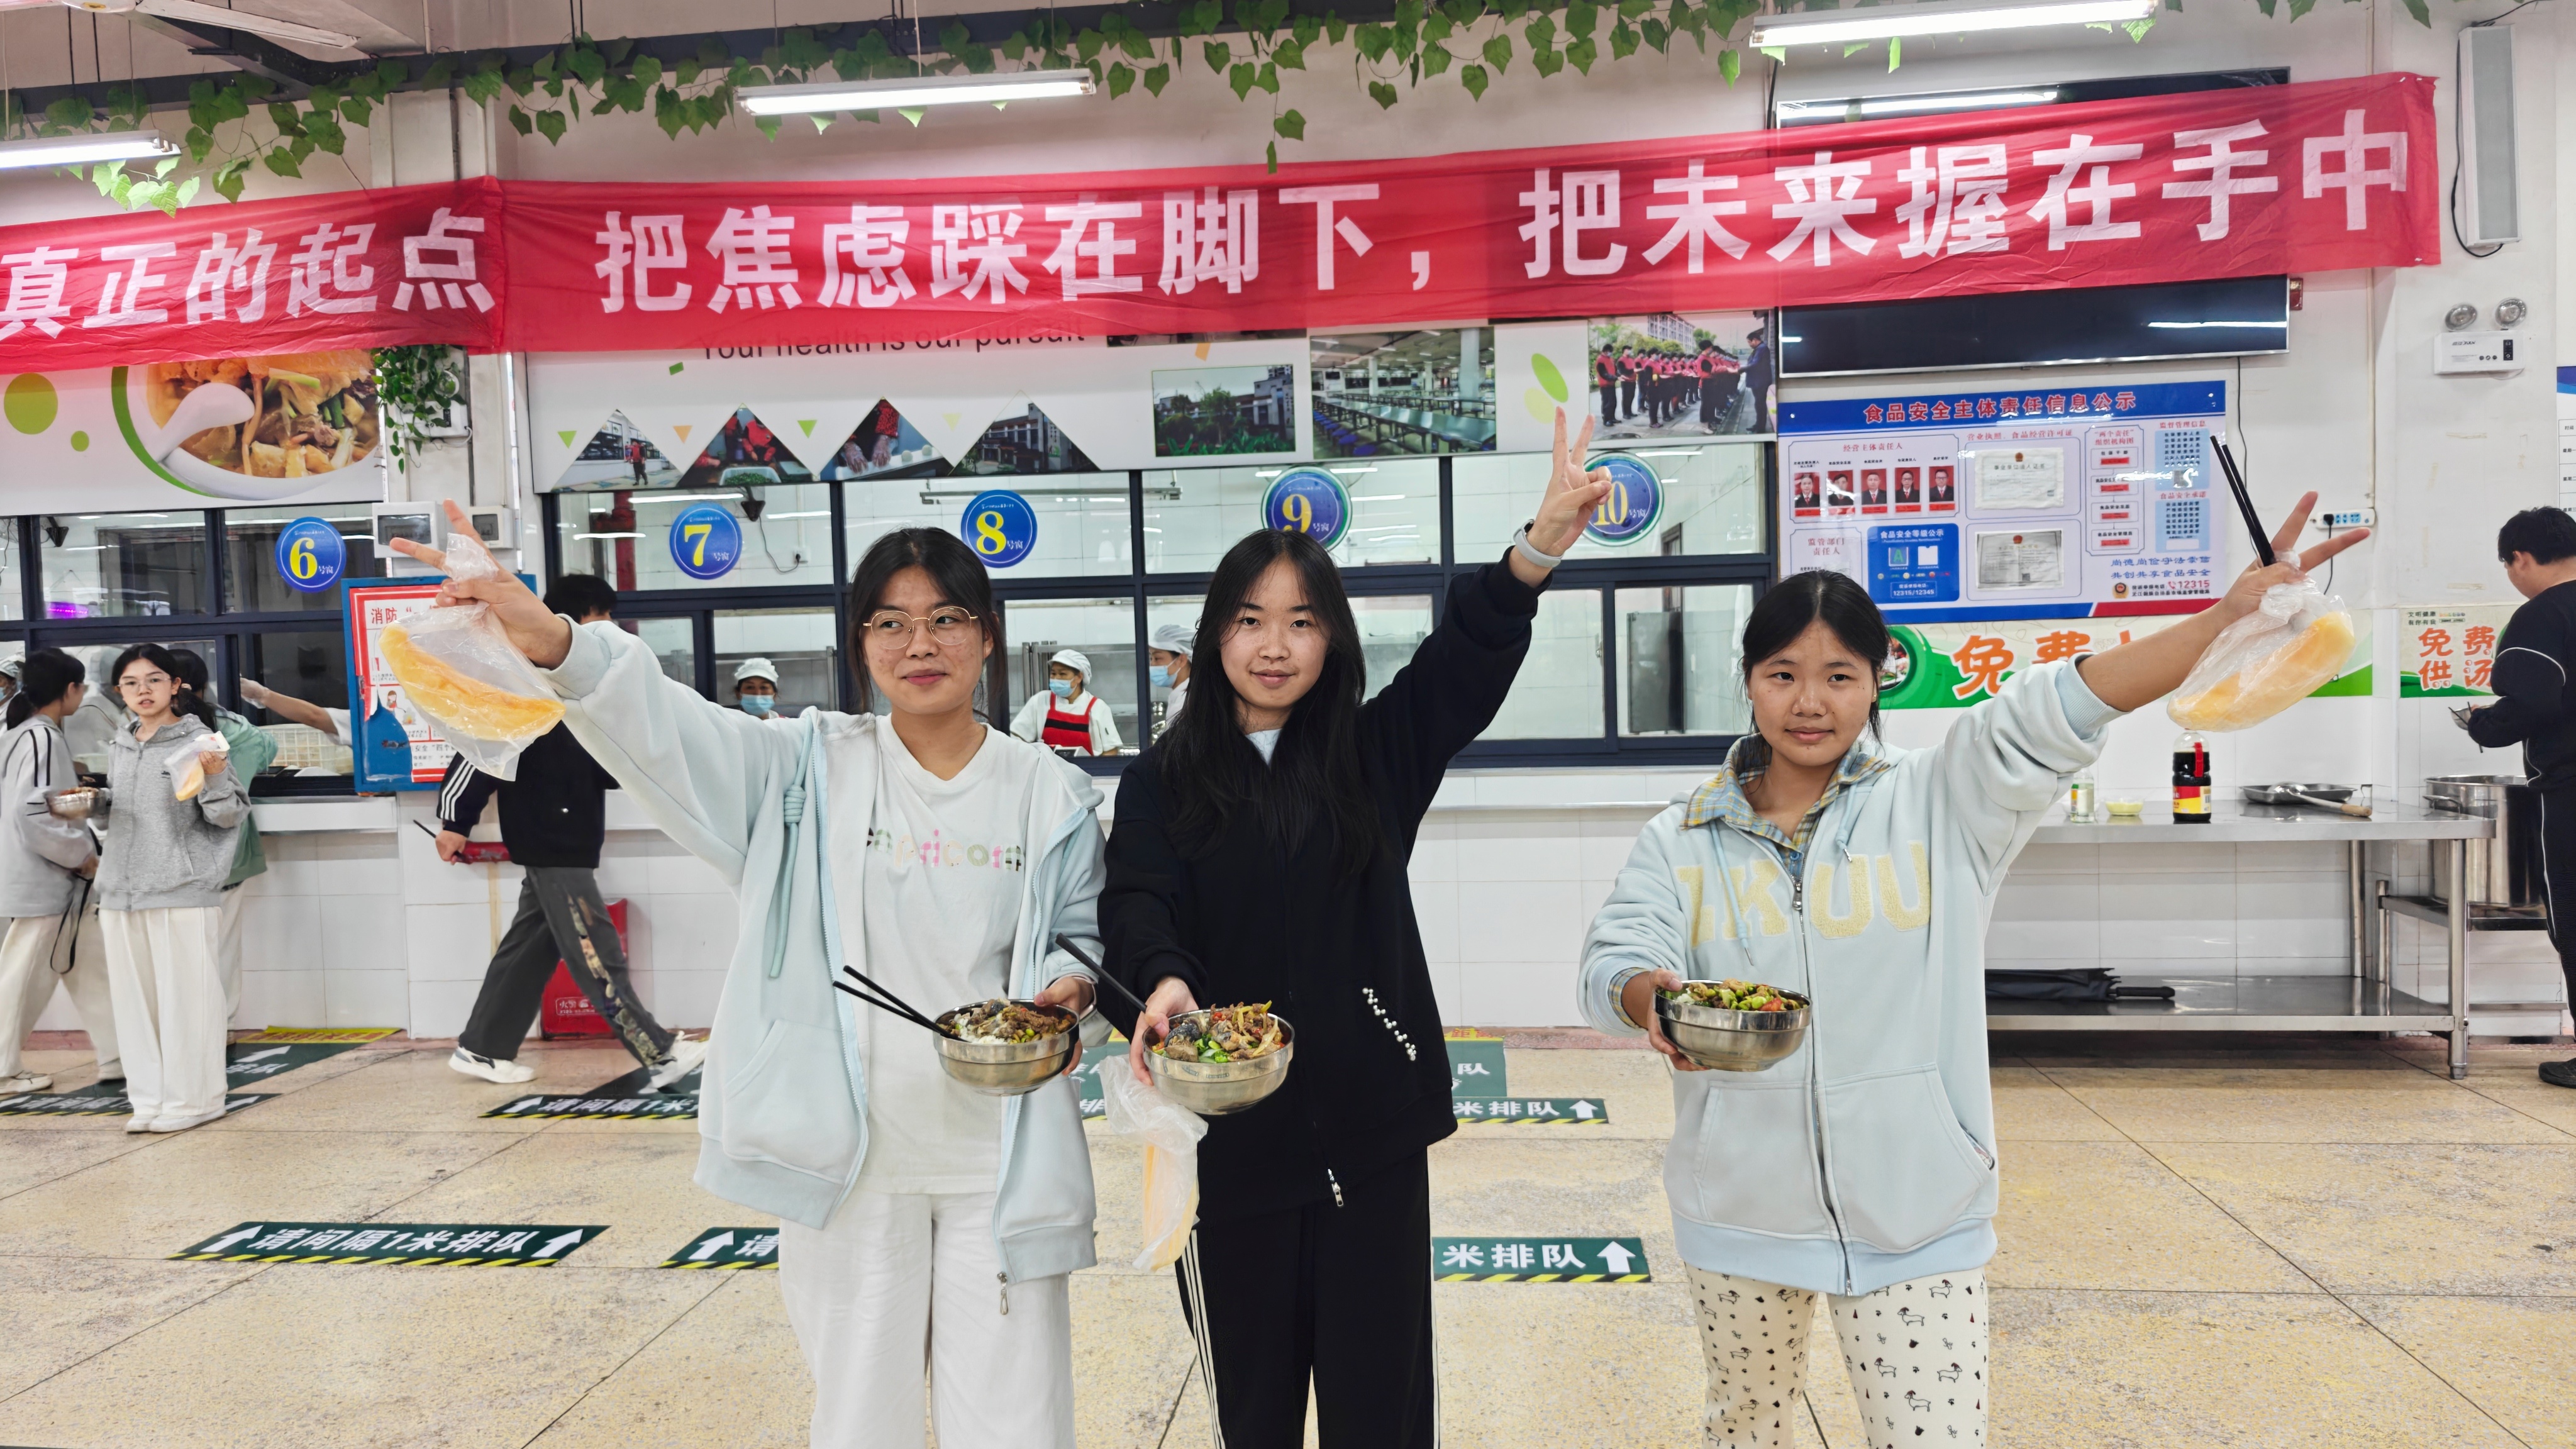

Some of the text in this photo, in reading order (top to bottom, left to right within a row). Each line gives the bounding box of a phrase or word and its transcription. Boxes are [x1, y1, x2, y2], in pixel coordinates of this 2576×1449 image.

[1863, 391, 2136, 424] 食品安全主体责任信息公示
[1843, 442, 1903, 452] 经营主体责任人
[1880, 528, 1945, 539] 食品安全等级公示
[1807, 538, 1845, 547] 监管部门
[1813, 547, 1840, 556] 责任人
[2178, 580, 2210, 589] 12315
[2418, 626, 2496, 658] 免费
[2418, 659, 2492, 691] 供汤
[538, 1098, 698, 1113] 请间隔1米
[247, 1226, 541, 1254] 请间隔1米排队
[1441, 1243, 1586, 1269] 米排队
